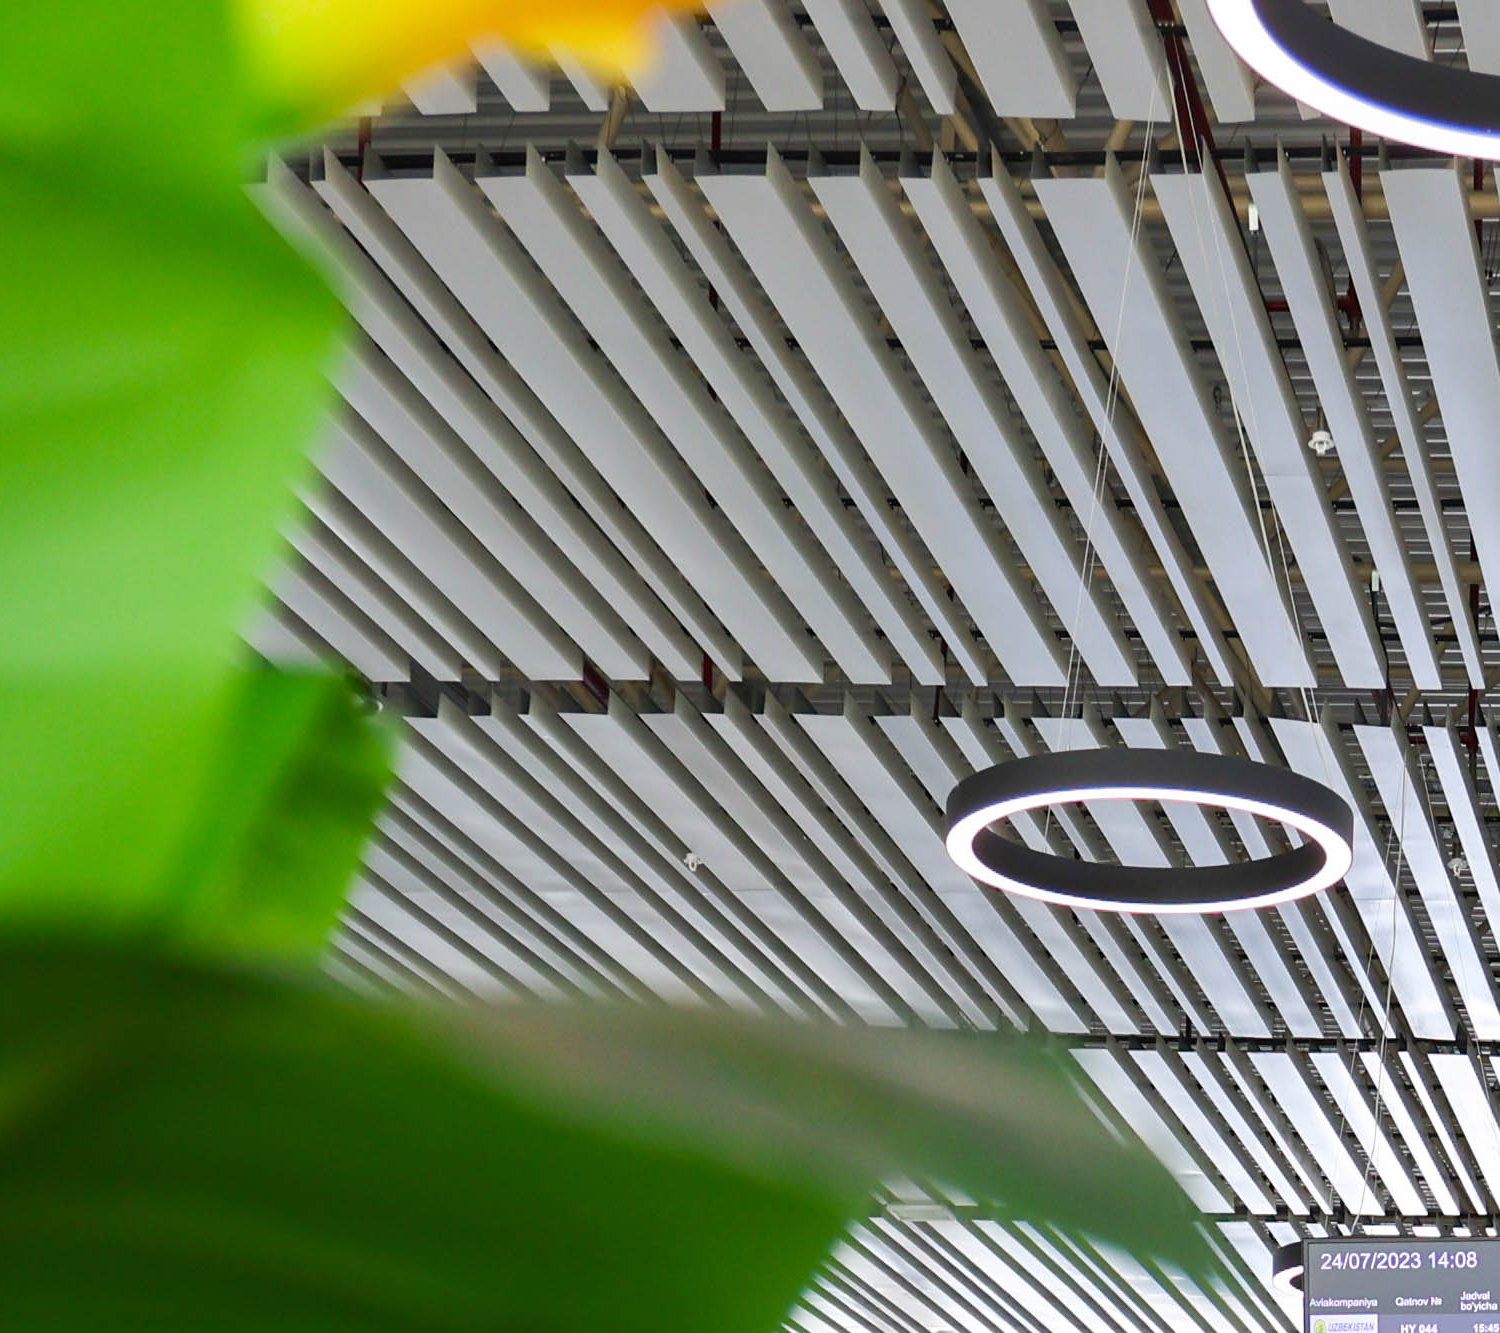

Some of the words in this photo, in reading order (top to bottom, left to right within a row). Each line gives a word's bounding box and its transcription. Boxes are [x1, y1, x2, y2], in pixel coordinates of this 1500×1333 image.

[1320, 1251, 1422, 1271] 24/07/2023
[1428, 1251, 1478, 1269] 14:08
[1460, 1290, 1490, 1301] Jadval
[1309, 1298, 1378, 1309] Aviakompaniya
[1395, 1297, 1429, 1307] Qatnov
[1328, 1323, 1374, 1332] UZBEKISTAN
[1400, 1324, 1416, 1333] HY
[1418, 1324, 1438, 1333] 044
[1473, 1324, 1500, 1333] 15:45
